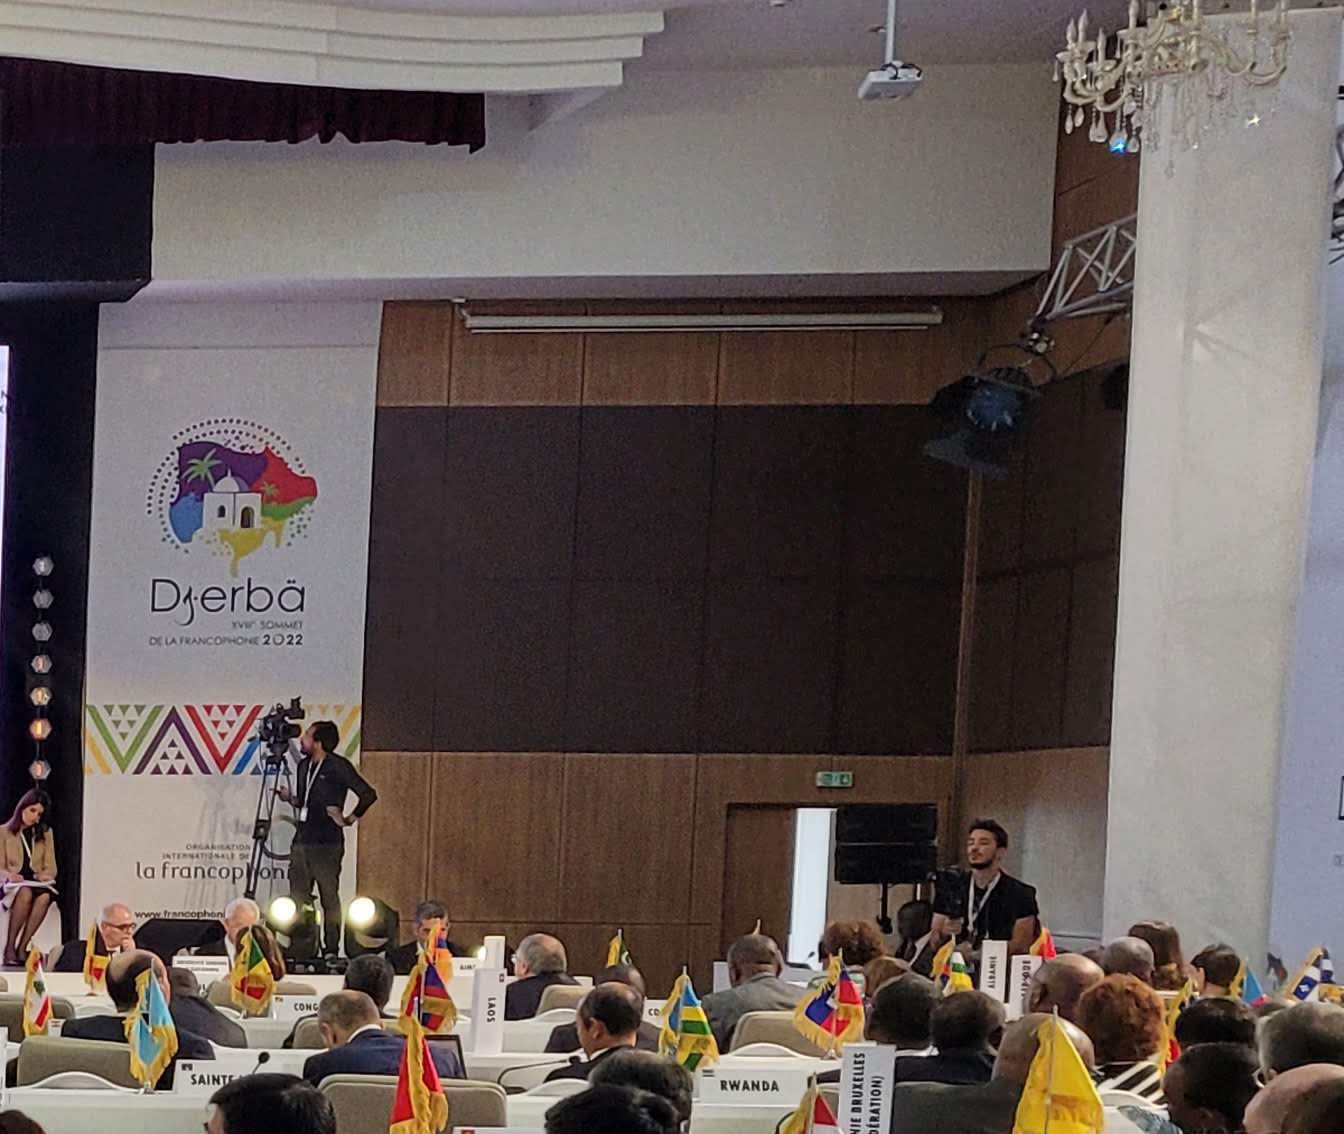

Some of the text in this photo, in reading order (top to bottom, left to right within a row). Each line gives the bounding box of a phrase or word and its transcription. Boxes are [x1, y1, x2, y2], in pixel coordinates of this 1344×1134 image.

[260, 620, 303, 630] SOMMET
[149, 634, 304, 646] DE LA FRANCOPHONIE 2022
[136, 861, 155, 879] la
[294, 1002, 319, 1012] CONG
[486, 997, 497, 1023] LAOS
[720, 1080, 780, 1092] RWANDA
[850, 1052, 866, 1114] BRUXELLES
